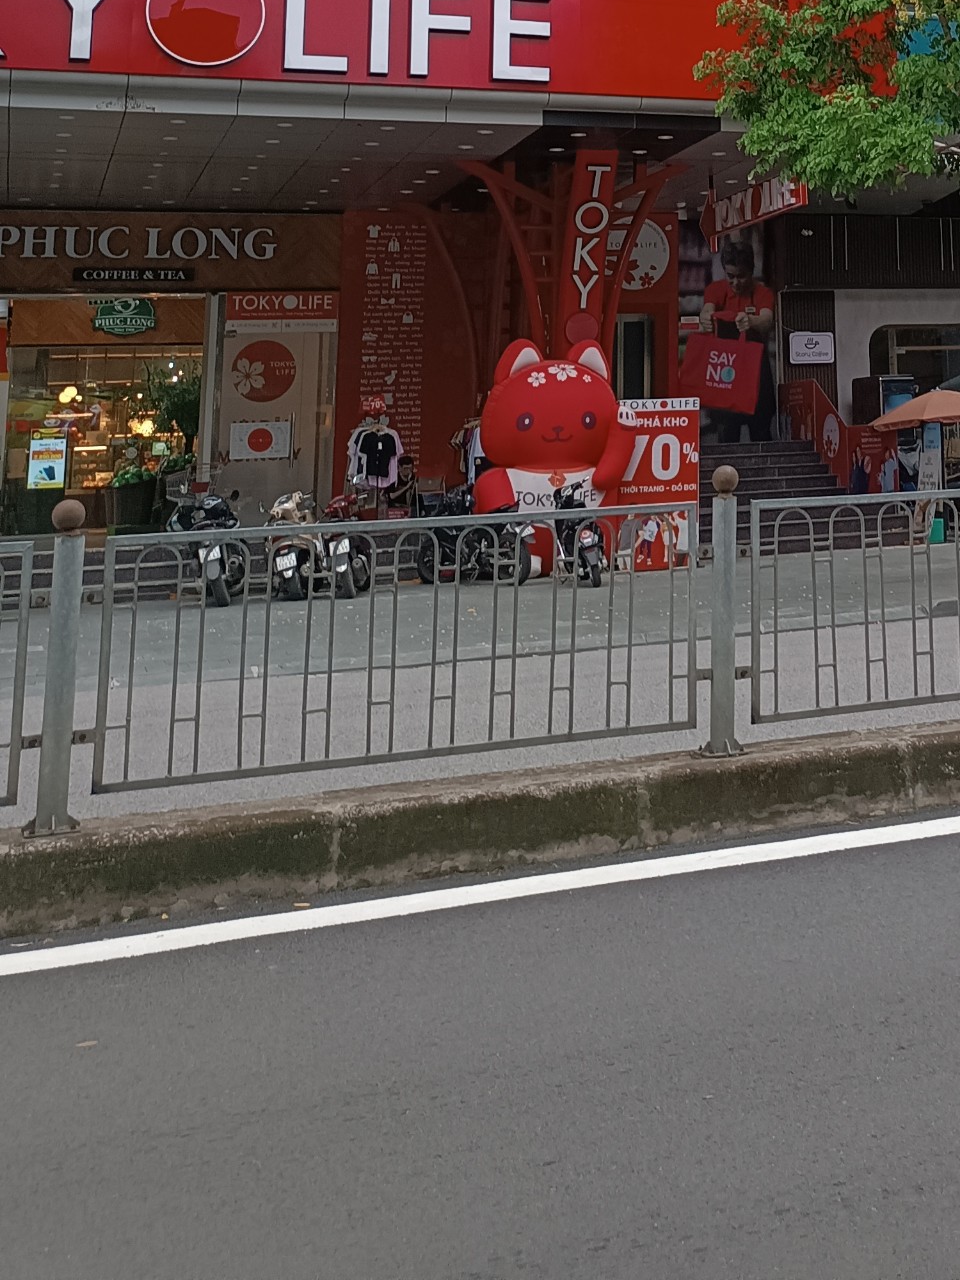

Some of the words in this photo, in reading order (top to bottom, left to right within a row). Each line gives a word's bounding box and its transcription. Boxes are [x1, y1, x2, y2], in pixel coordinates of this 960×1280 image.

[0, 226, 131, 259] PHUC
[143, 226, 278, 260] LONG
[82, 269, 139, 280] COFFEE
[143, 270, 155, 280] &
[158, 270, 186, 280] TEA
[232, 294, 333, 311] TOKYOLIFE
[95, 317, 125, 327] PHUC
[126, 317, 155, 328] LONG
[269, 360, 296, 368] TOKYO
[708, 350, 737, 366] SAY
[276, 368, 296, 376] LIFE
[706, 364, 736, 383] NO
[637, 414, 661, 428] PHÁ
[663, 416, 689, 427] KHO
[639, 484, 665, 494] TRANG
